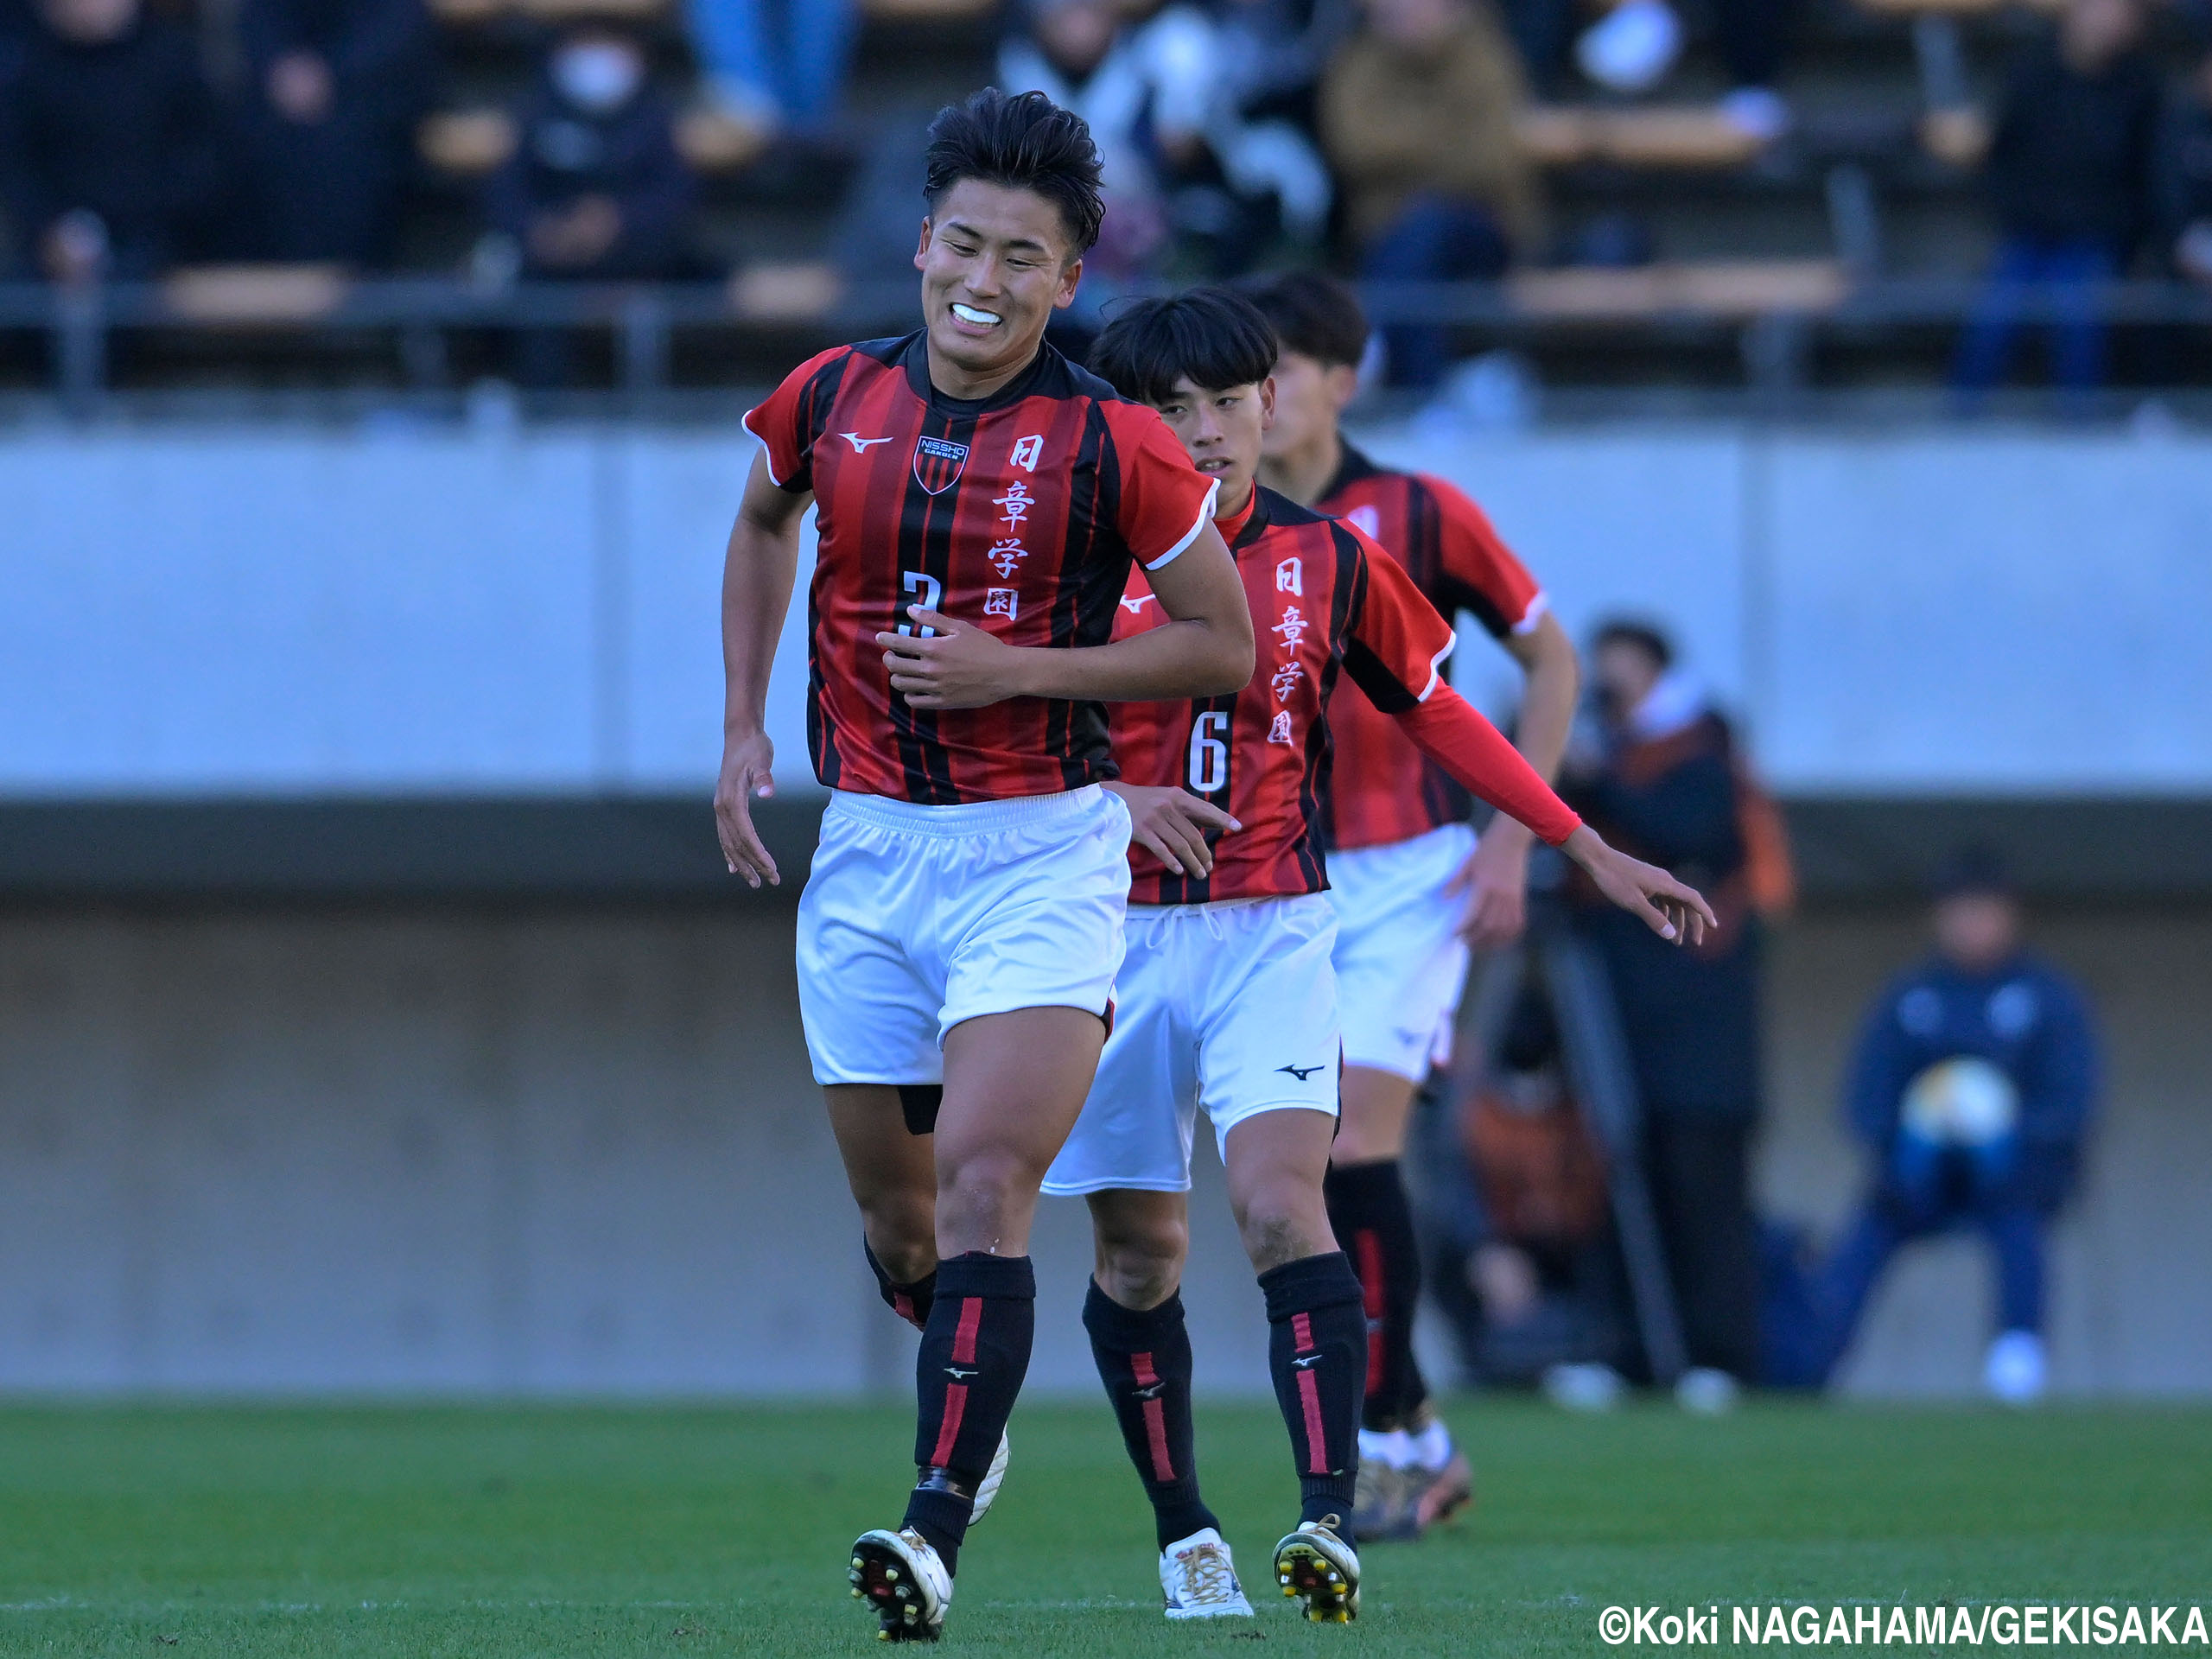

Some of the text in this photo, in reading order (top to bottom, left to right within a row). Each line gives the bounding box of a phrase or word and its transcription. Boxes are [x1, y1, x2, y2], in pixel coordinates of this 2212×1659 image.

[921, 439, 965, 456] NISSHO
[983, 434, 1044, 621] 日章学園
[1267, 556, 1309, 747] 日章学園
[1189, 711, 1228, 791] 6
